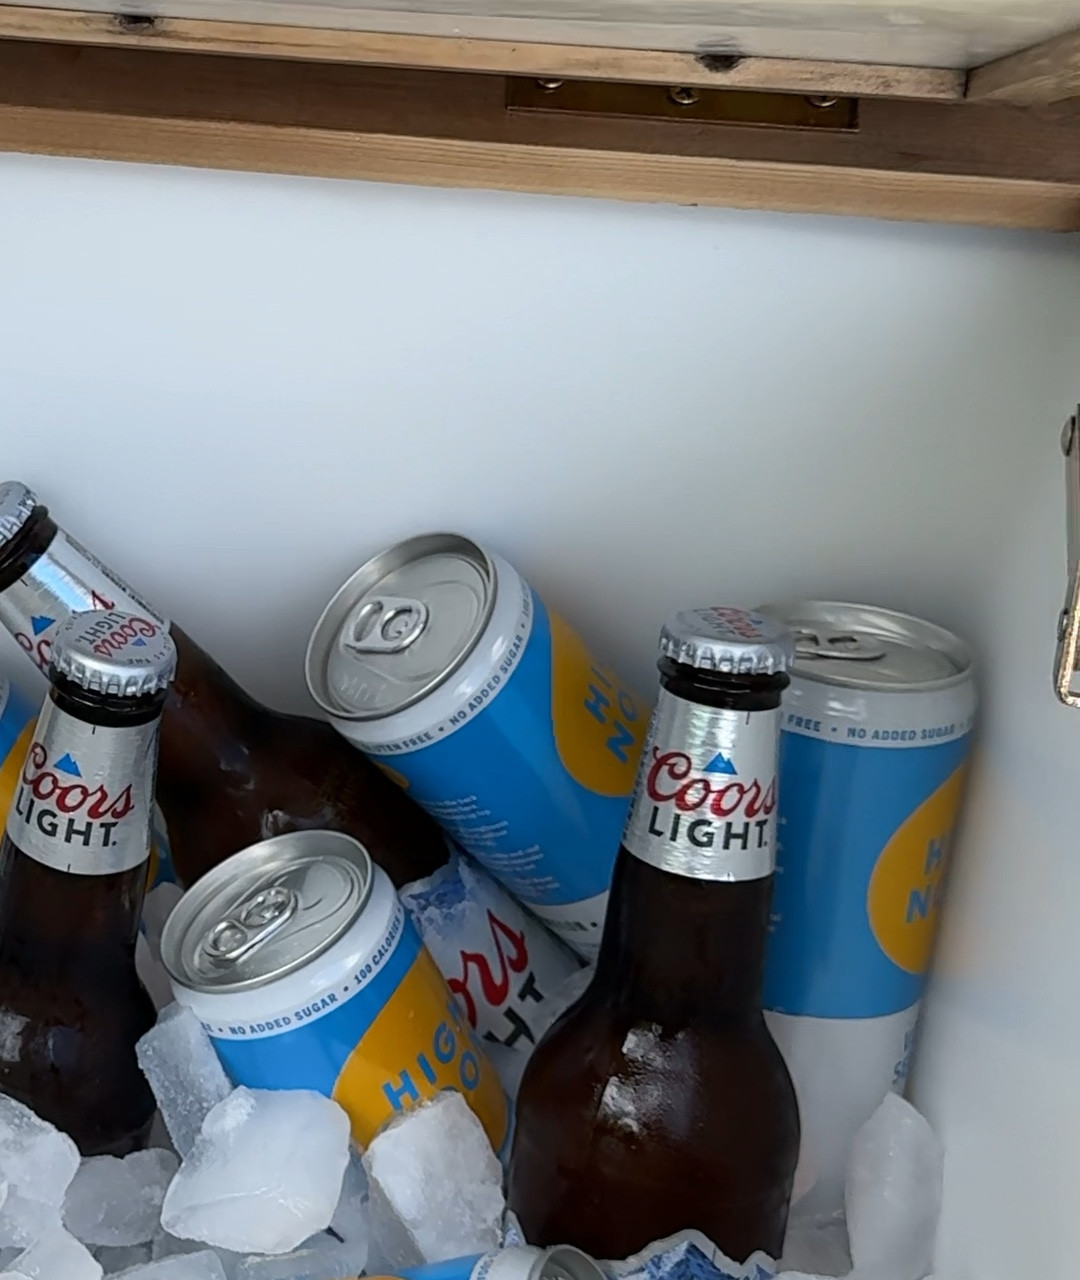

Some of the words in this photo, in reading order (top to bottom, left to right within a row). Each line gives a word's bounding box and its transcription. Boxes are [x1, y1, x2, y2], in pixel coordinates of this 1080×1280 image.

[79, 612, 126, 645] LIGHT
[93, 617, 161, 658] Coors
[449, 710, 467, 726] NO
[468, 675, 501, 712] ADDED
[500, 635, 523, 674] SUGAR
[787, 714, 822, 732] FREE
[847, 727, 867, 739] NO
[871, 729, 917, 741] ADDED
[920, 723, 956, 740] SUGAR
[22, 742, 135, 820] Coors
[647, 745, 776, 819] Coors
[16, 786, 119, 847] LIGHT
[648, 805, 769, 851] LIGHT
[228, 1026, 247, 1036] NO
[249, 1016, 292, 1034] ADDED
[294, 993, 339, 1022] SUGAR
[354, 963, 373, 985] 100
